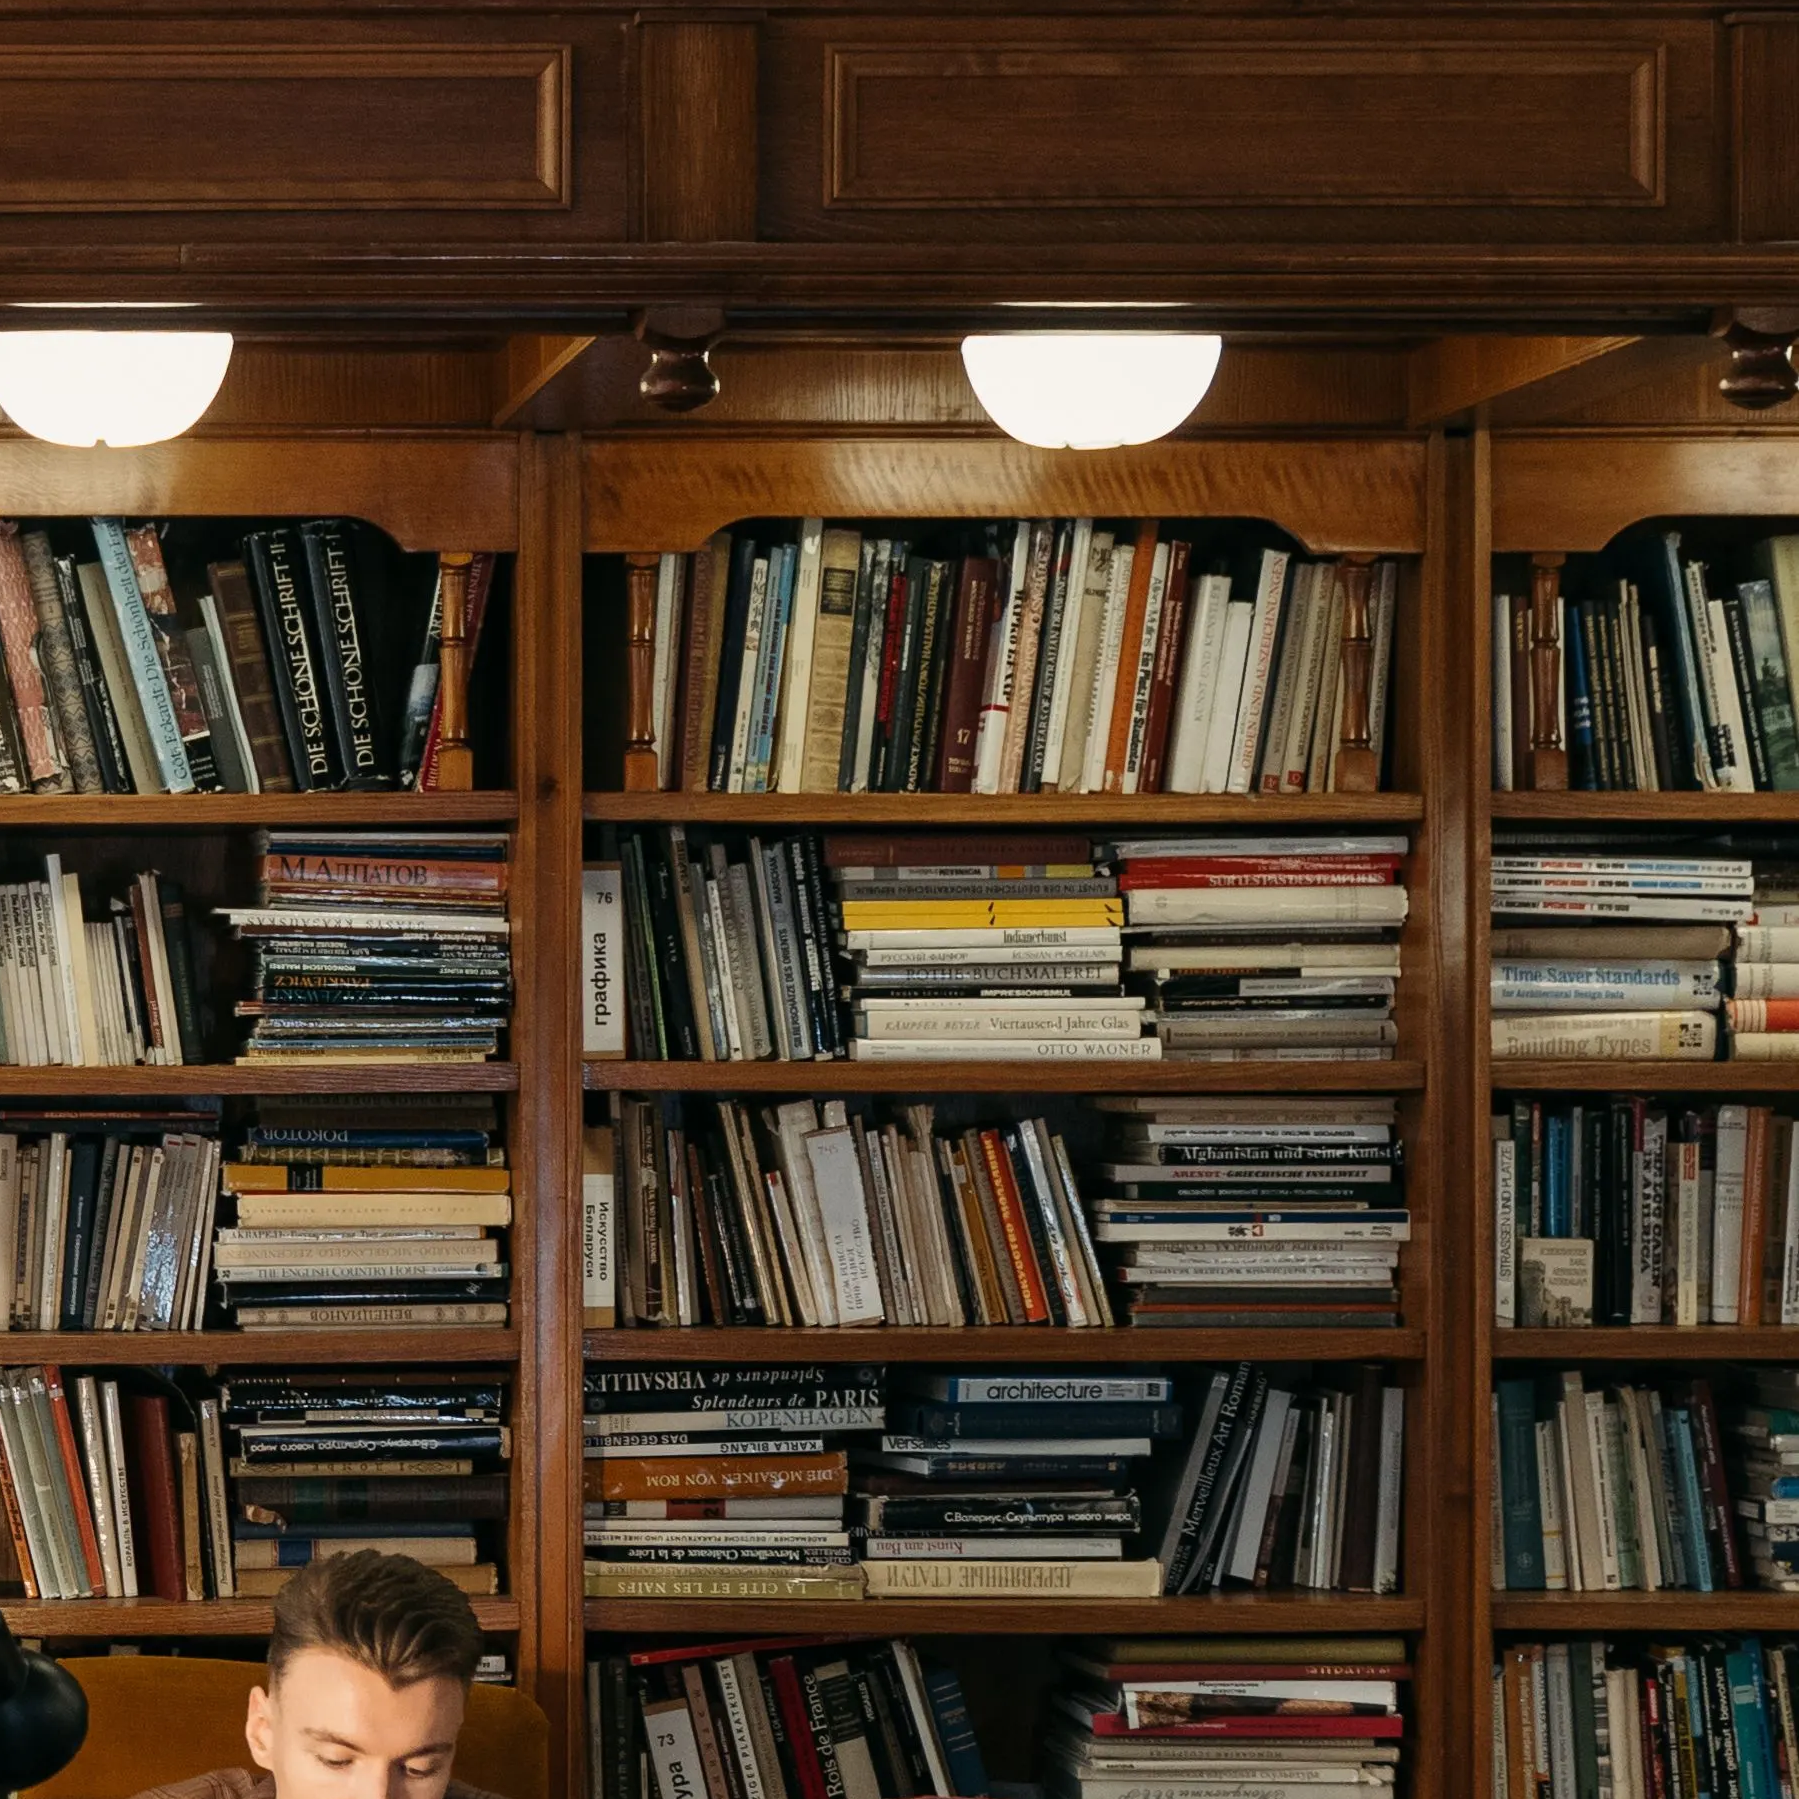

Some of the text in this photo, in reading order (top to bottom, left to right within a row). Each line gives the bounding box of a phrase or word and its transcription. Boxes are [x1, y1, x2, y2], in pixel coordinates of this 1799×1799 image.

[112, 548, 131, 574] der
[119, 574, 151, 650] Schönheit
[1241, 555, 1285, 768] ORDEN UND AUSZEICHNUNGEN
[288, 648, 323, 738] SCHÖNE
[336, 636, 370, 729] SCHÖNE
[304, 739, 329, 774] DIE
[348, 731, 376, 766] DIE
[768, 855, 783, 903] MARSCHAK
[1209, 874, 1234, 887] SUR
[595, 889, 614, 903] 76
[779, 927, 792, 963] ORIENTS
[1003, 928, 1067, 944] Indianerkunst
[590, 931, 611, 1025] графика
[783, 964, 795, 982] DES
[1593, 967, 1682, 986] Standards
[1502, 988, 1625, 1001] for Architectural Design Data
[989, 1016, 1063, 1031] Viertausend
[1063, 1017, 1098, 1034] Jahre
[1100, 1015, 1131, 1030] Glas
[1037, 1043, 1152, 1056] OTTO WAGNER
[1506, 1035, 1652, 1059] Building Types
[1181, 1145, 1392, 1164] Afghanistan und seine Kunst
[1499, 1189, 1512, 1215] UND
[582, 1204, 596, 1279] Беларуси
[593, 1201, 610, 1282] Искусство
[1499, 1215, 1513, 1277] STRASSEN
[281, 1266, 330, 1278] ENGLISH
[330, 1265, 393, 1277] COUNTRY
[309, 1308, 413, 1322] ВЕНЕЦИАНОВ
[712, 1370, 731, 1386] de
[736, 1366, 826, 1384] Splendeurs
[691, 1387, 880, 1410] Splendeurs de PARIS
[986, 1380, 1103, 1401] architecture
[725, 1408, 874, 1428] KOPENHAGEN
[720, 1439, 817, 1453] KARLA BILANG
[1180, 1359, 1252, 1537] Merveilleux Art Roman
[645, 1469, 833, 1488] DIE MOSAIKEN VON ROM
[117, 1465, 129, 1516] ИСКУССТВЕ
[123, 1526, 133, 1567] КОРАБЛЬ
[626, 1547, 799, 1561] Merveilleux Châteaux de la Loire
[875, 1541, 902, 1554] Bau
[929, 1540, 964, 1553] Kunst
[739, 1579, 779, 1595] CITÉ
[886, 1564, 1076, 1588] ДЕРЕВЯННЫЕ СТАТУИ
[673, 1582, 704, 1595] LES
[710, 1582, 731, 1595] ET
[786, 1581, 807, 1595] LA
[802, 1672, 826, 1731] France
[857, 1680, 876, 1722] VERSAILLES
[1713, 1666, 1729, 1721] bewohnt
[719, 1662, 752, 1758] PLAKATKUNST
[656, 1731, 676, 1747] 73
[814, 1732, 832, 1755] de
[1719, 1728, 1736, 1771] gebaut
[821, 1758, 841, 1796] Rois
